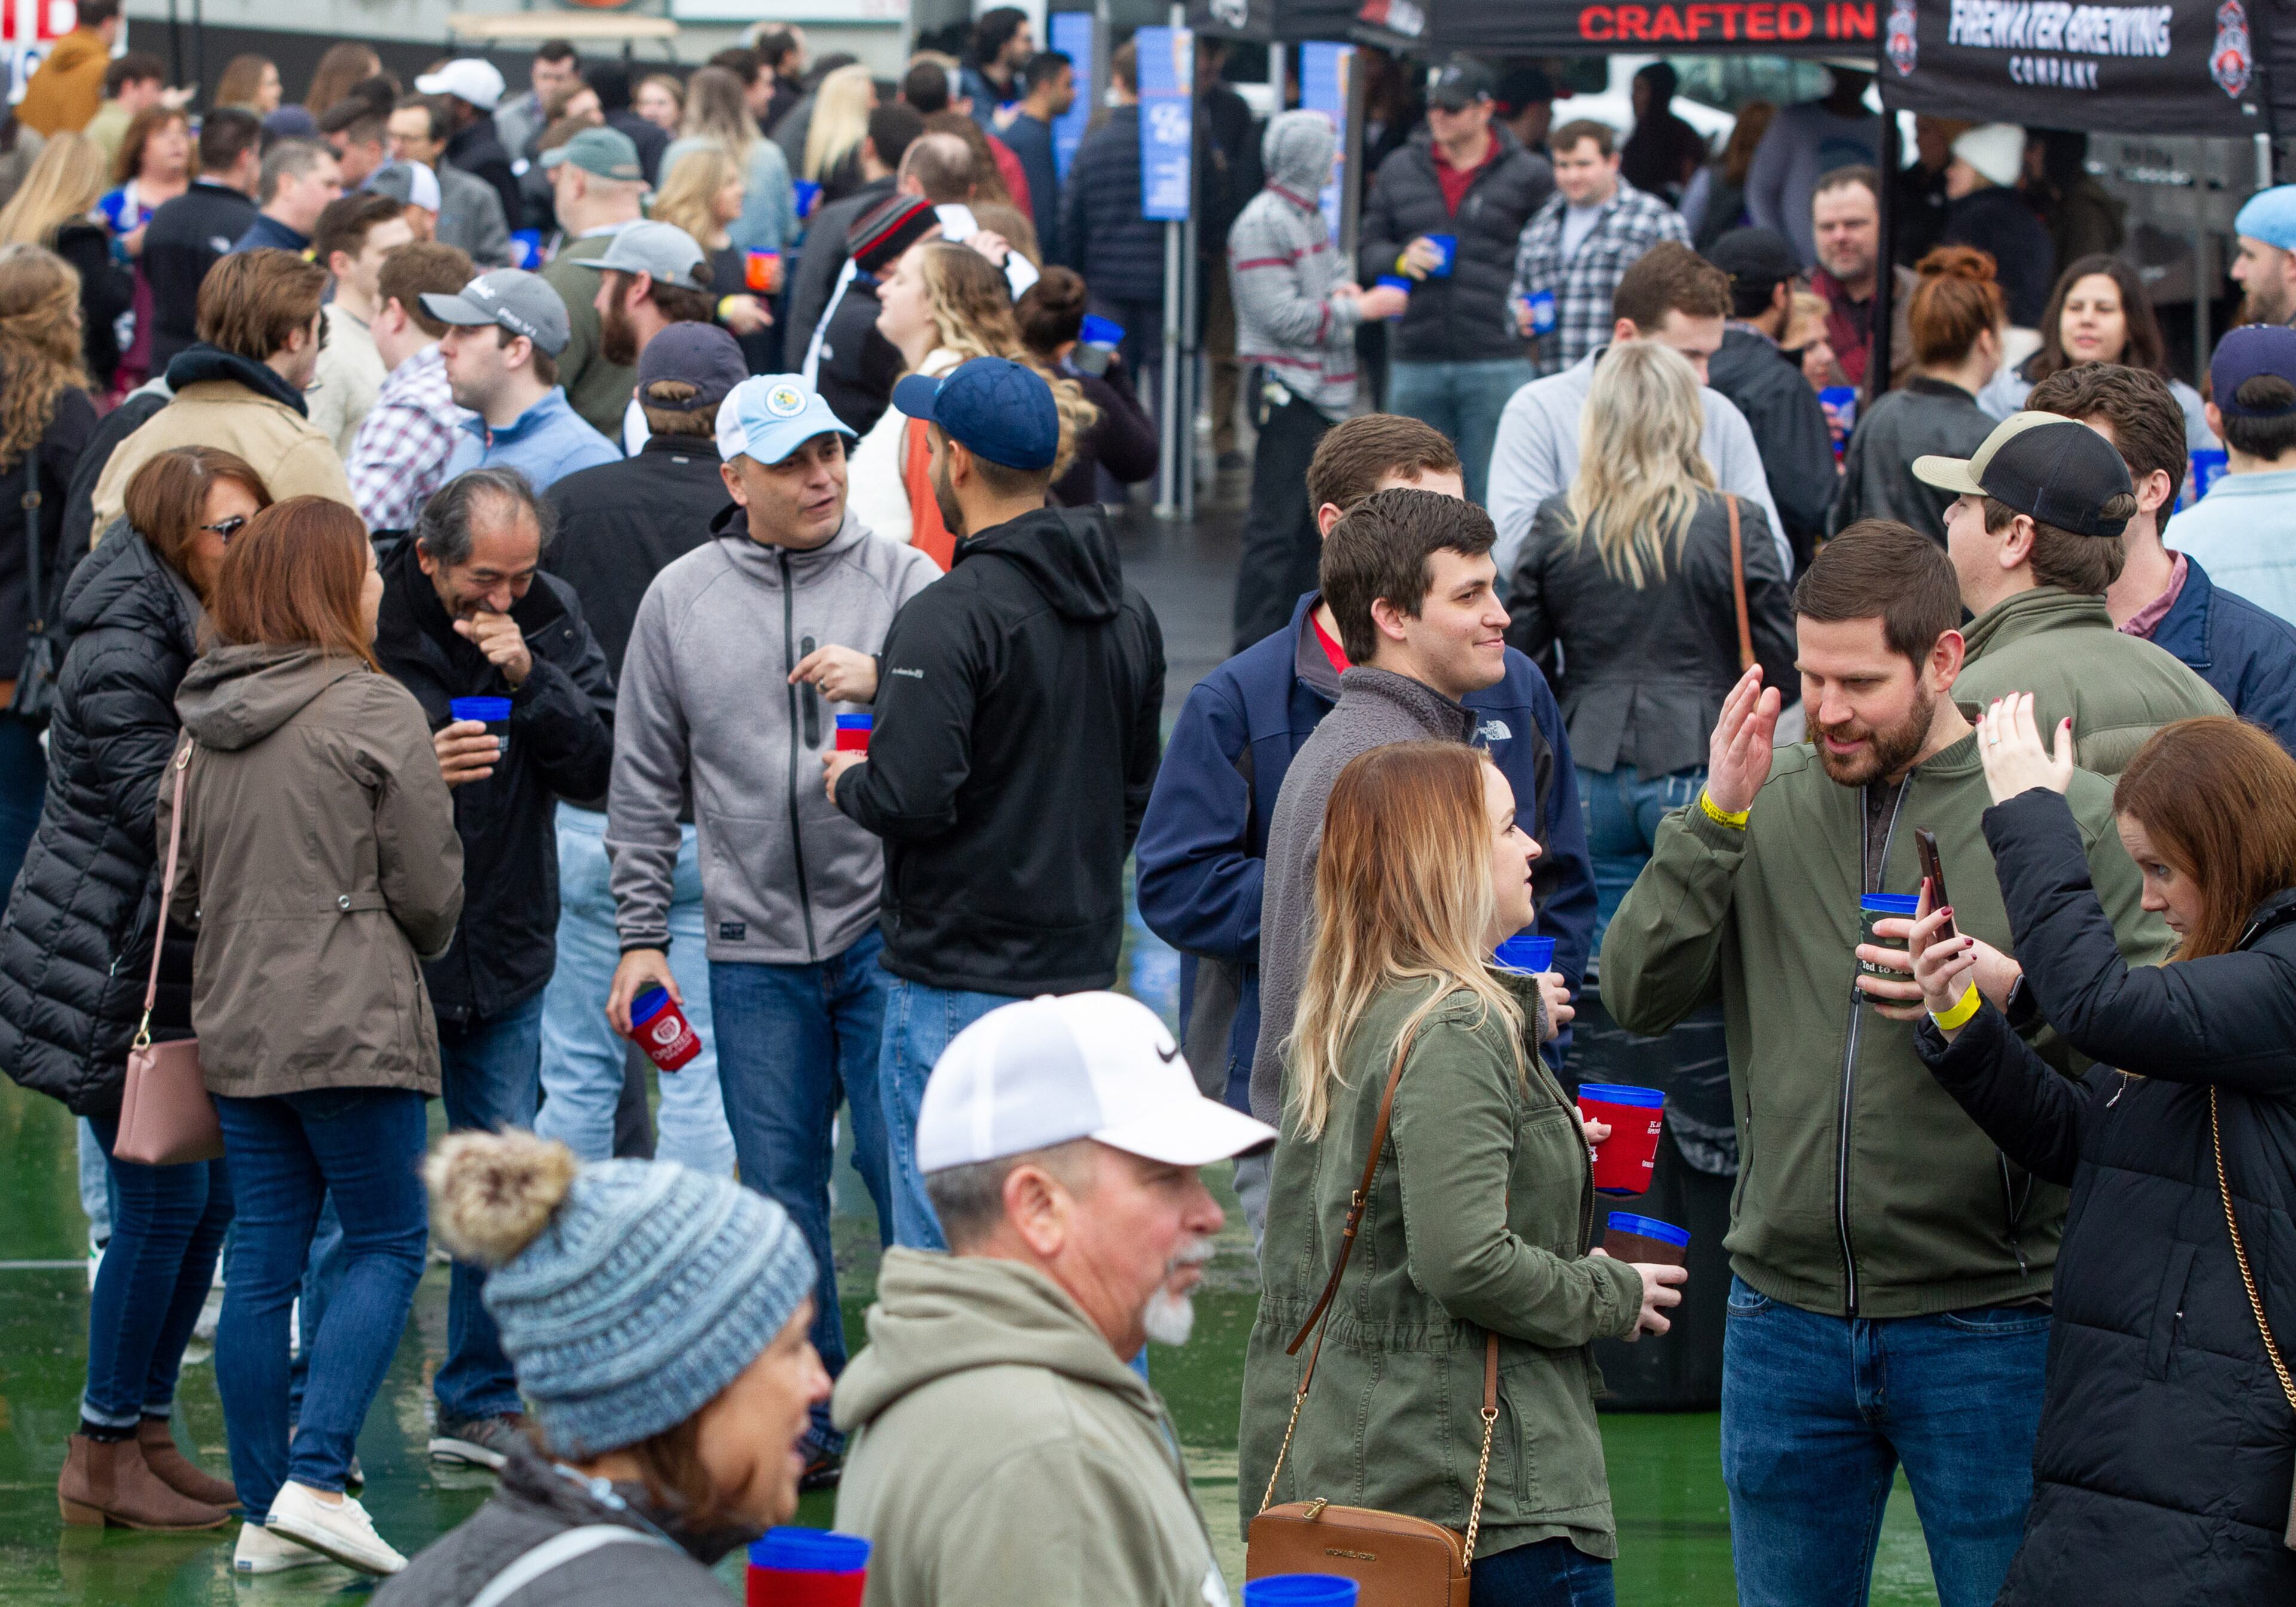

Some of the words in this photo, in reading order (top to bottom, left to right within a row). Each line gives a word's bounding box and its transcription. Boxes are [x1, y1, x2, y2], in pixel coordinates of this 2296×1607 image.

[1578, 4, 1813, 41] CRAFTED
[1825, 2, 1876, 39] IN
[2065, 4, 2173, 57] BREWING
[2008, 55, 2099, 90] COMPANY
[1358, 1552, 1377, 1561] KORS
